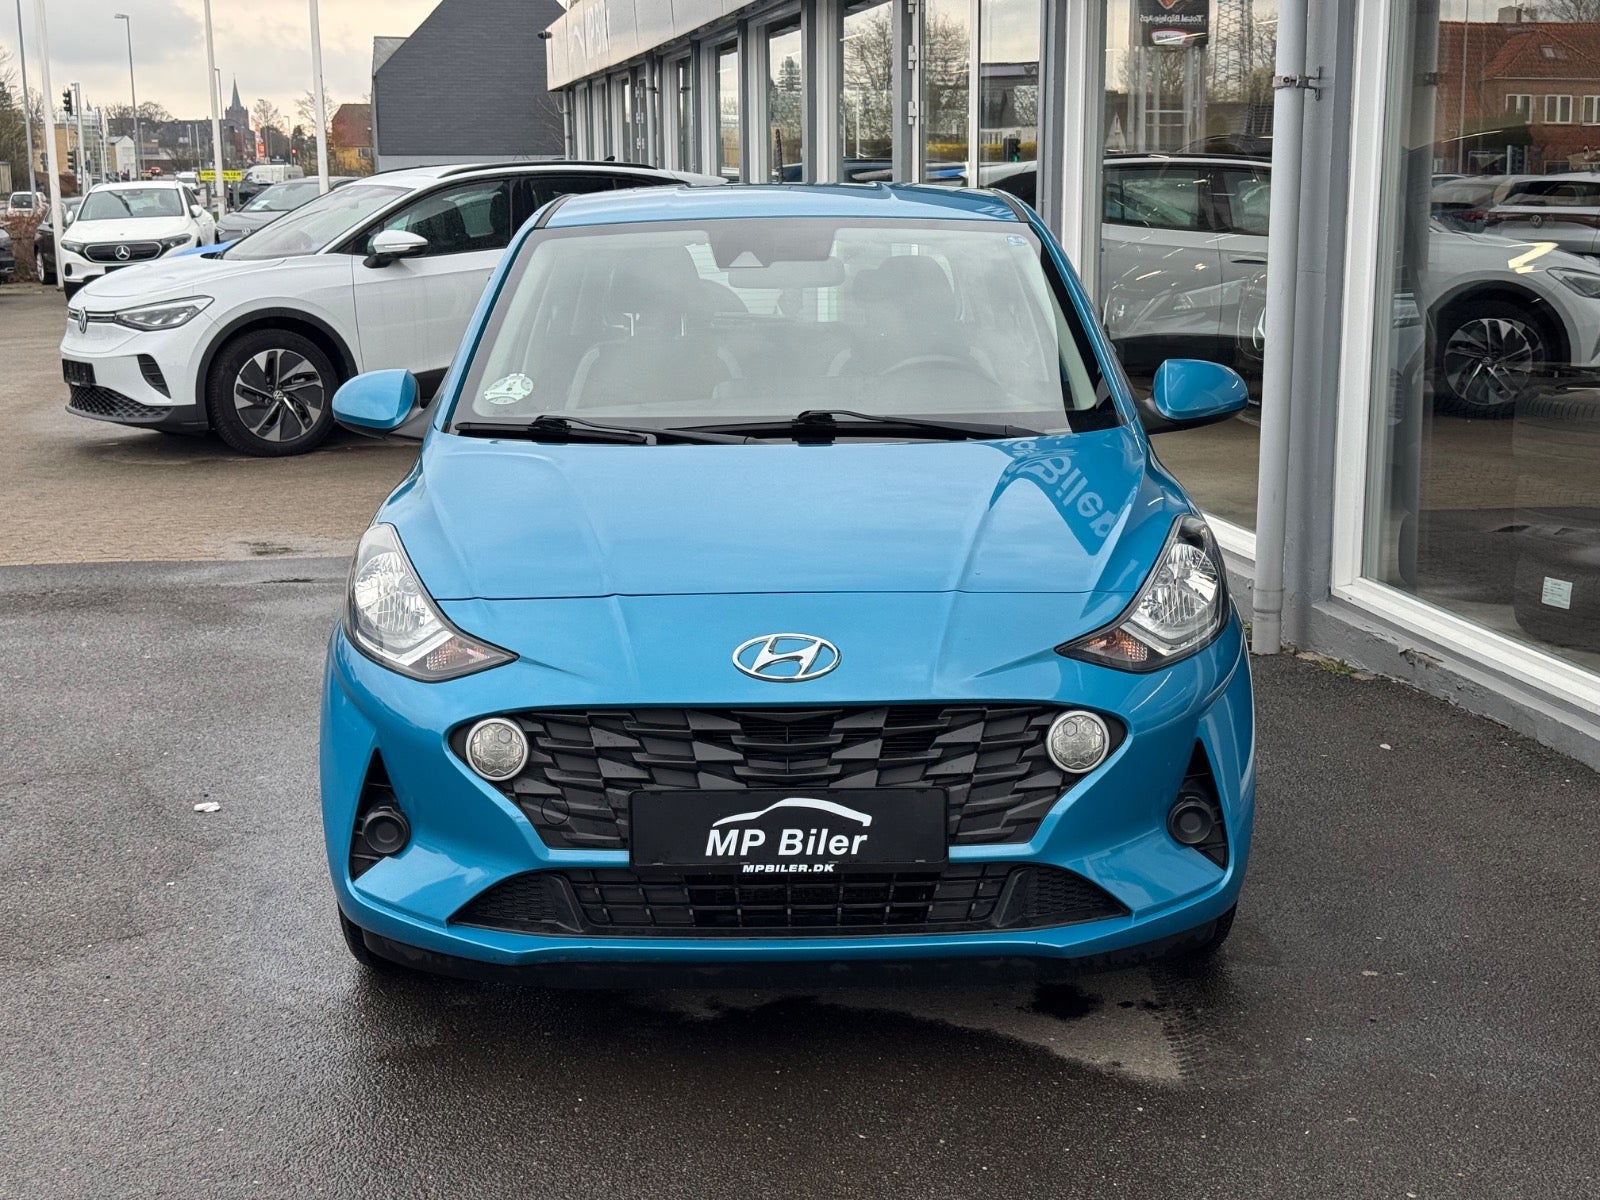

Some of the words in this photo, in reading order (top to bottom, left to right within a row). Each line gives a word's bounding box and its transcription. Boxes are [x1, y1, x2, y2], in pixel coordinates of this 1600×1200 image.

[705, 829, 766, 857] MP
[778, 828, 868, 856] Biler
[742, 863, 834, 873] MPBILER.DK
